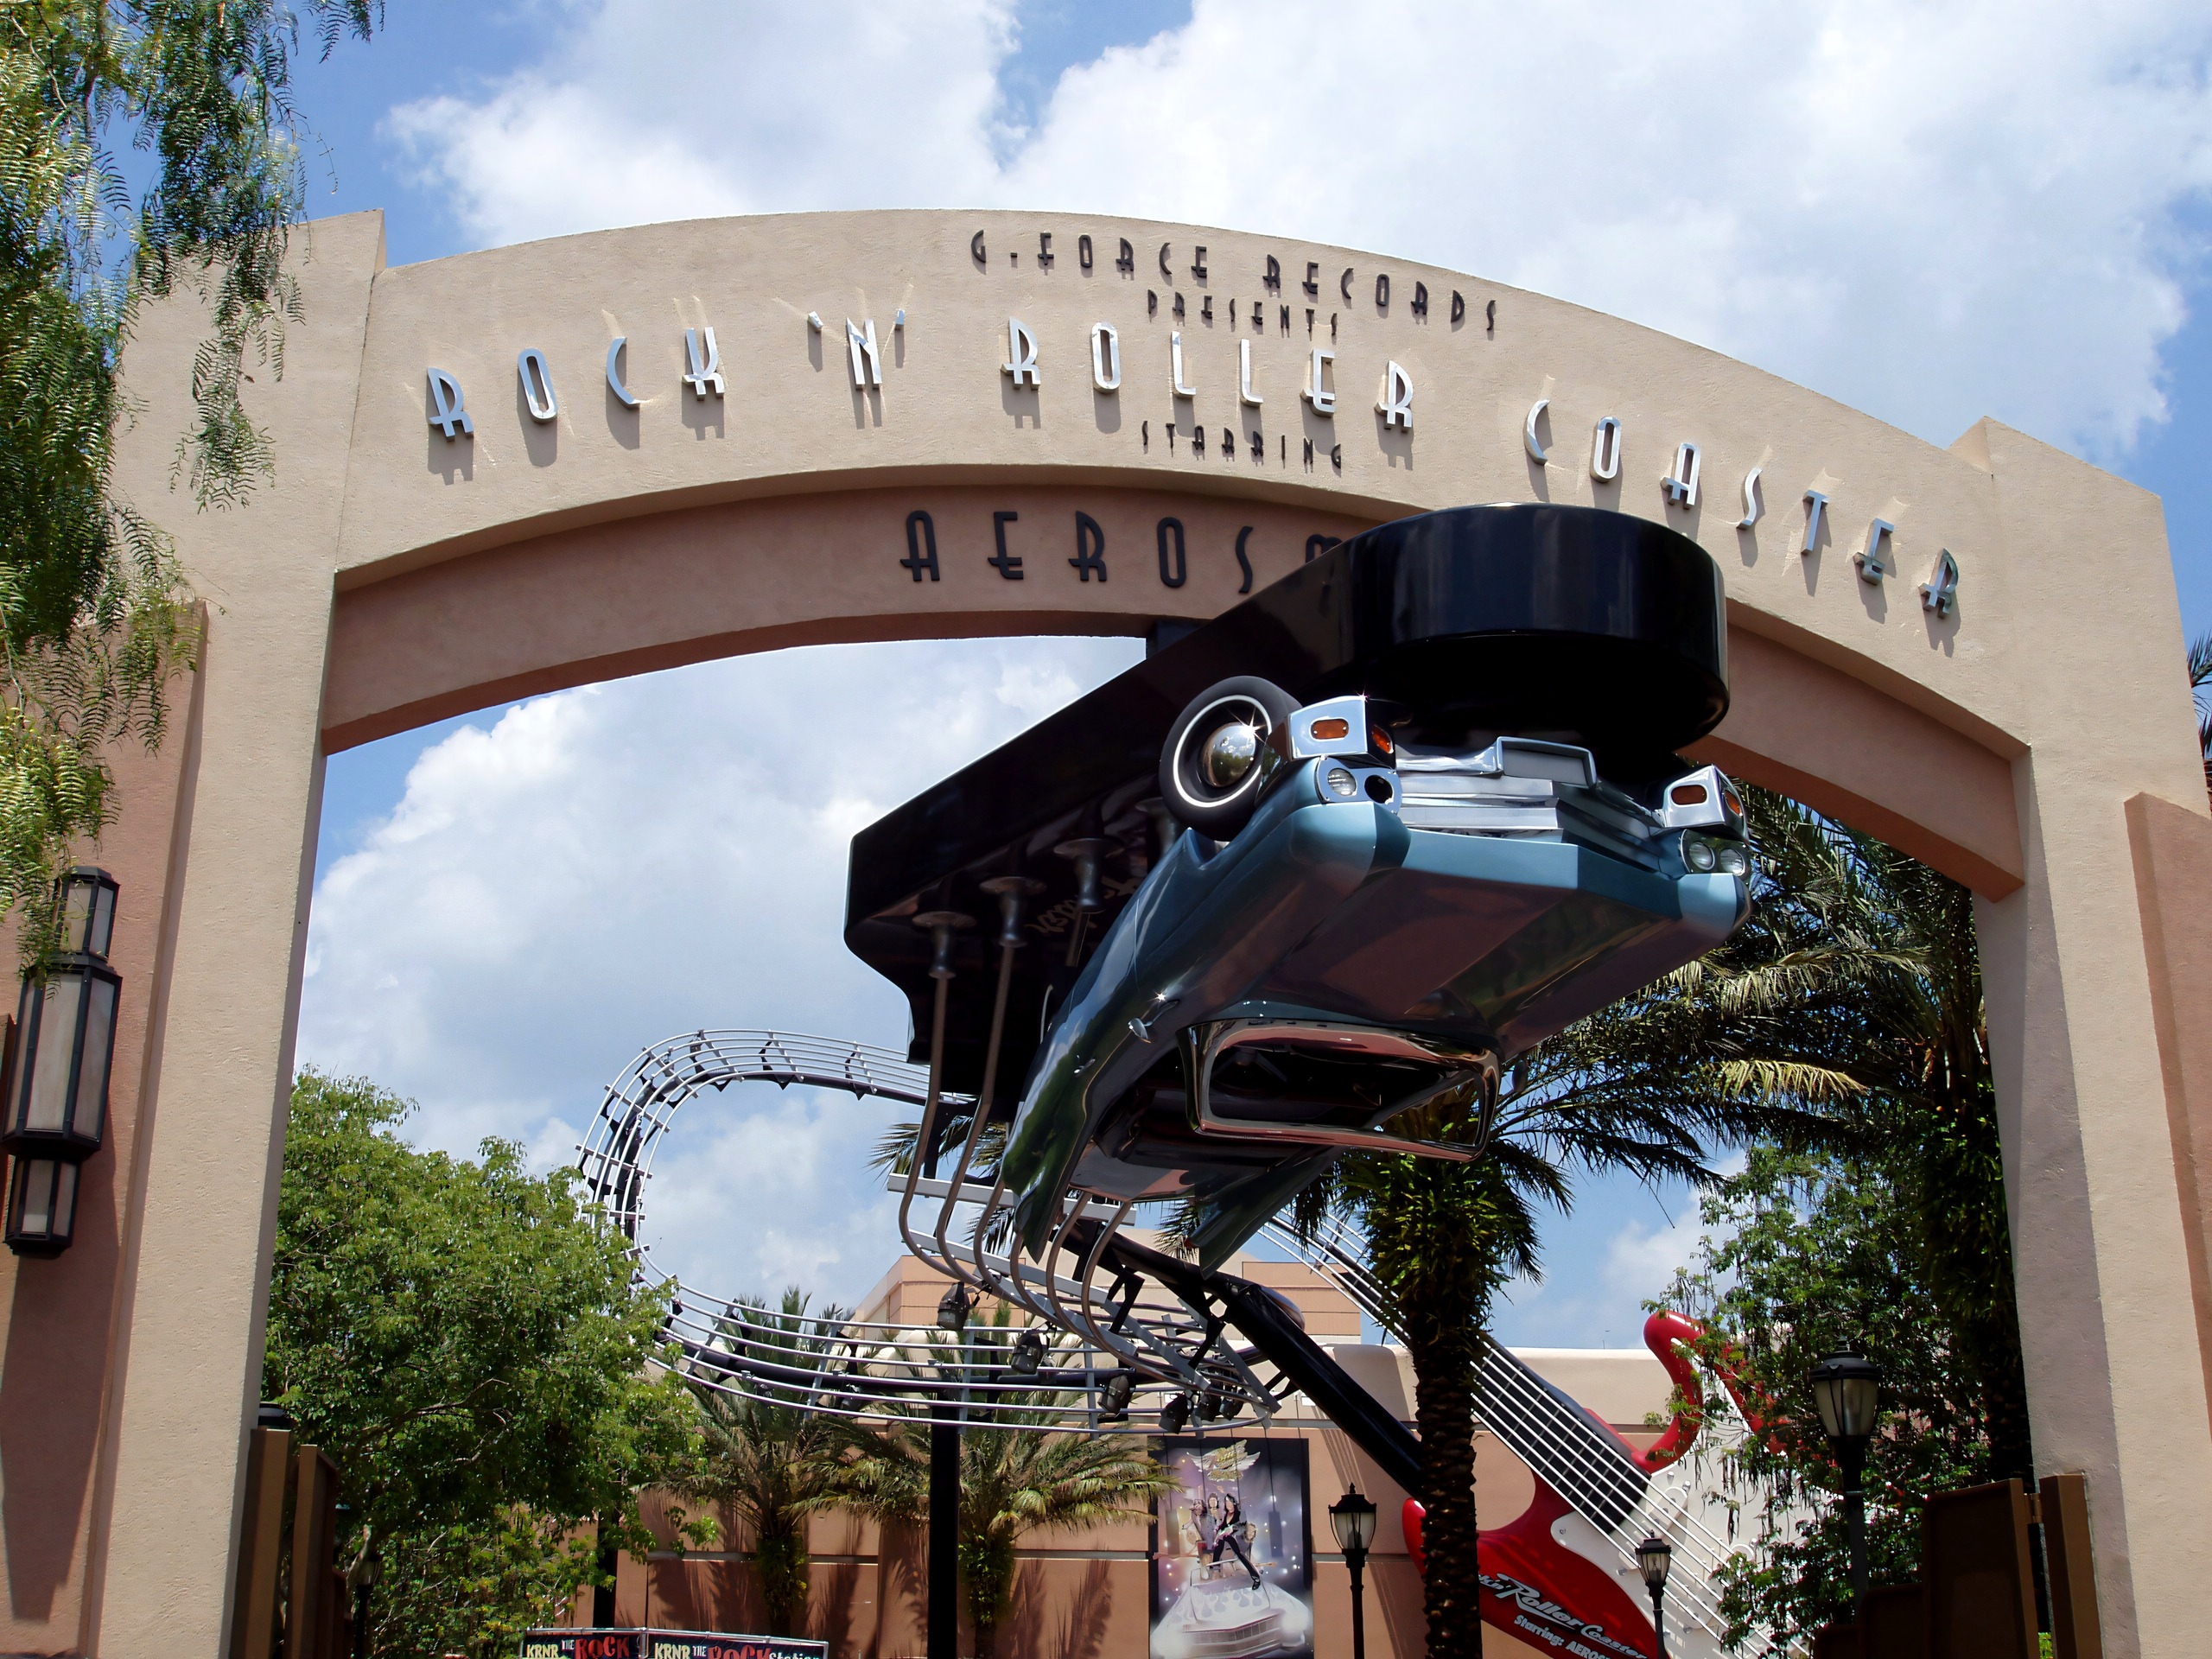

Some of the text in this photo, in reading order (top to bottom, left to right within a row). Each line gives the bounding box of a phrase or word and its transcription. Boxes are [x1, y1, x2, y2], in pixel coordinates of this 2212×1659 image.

[971, 229, 1497, 330] G-FORCE RECORDS
[1147, 289, 1337, 336] PRESENTS
[427, 325, 724, 442] ROCK
[1000, 317, 1413, 432] ROLLER
[1524, 398, 1959, 619] COASTER
[1141, 420, 1341, 469] STARRING
[1495, 1573, 1584, 1630] Roller
[526, 1636, 630, 1659] KRNR THE ROCK
[654, 1643, 691, 1659] KRNR
[692, 1645, 707, 1657] THE
[1513, 1614, 1565, 1646] Starring:
